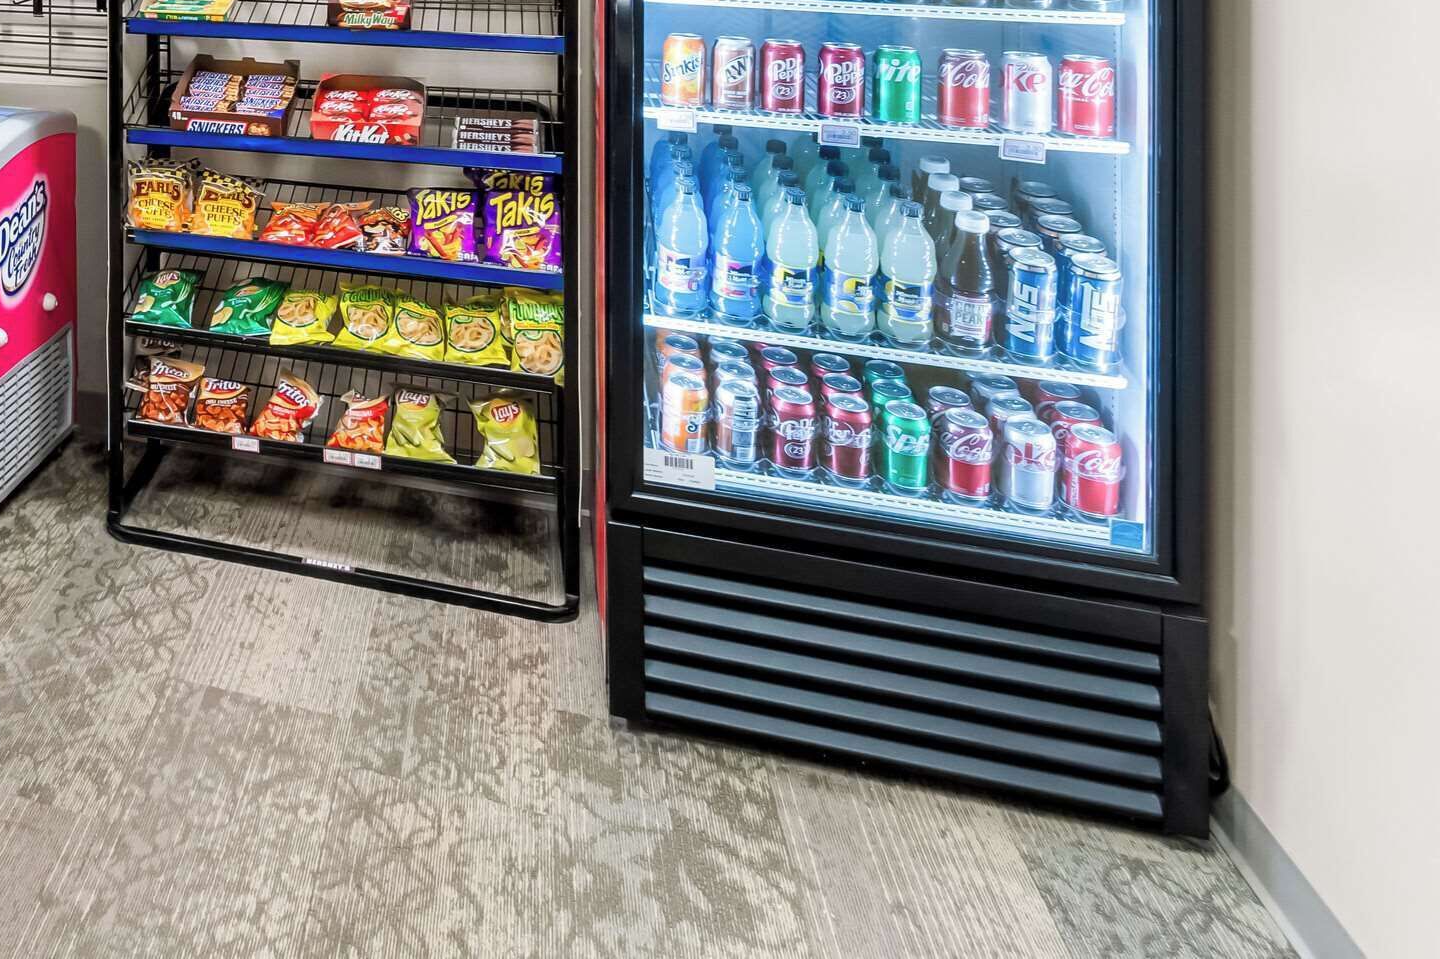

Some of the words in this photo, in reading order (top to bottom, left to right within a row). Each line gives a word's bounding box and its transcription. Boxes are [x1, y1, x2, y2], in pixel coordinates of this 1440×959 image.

[777, 85, 792, 96] 23
[835, 90, 848, 100] 23
[189, 120, 244, 135] SNICKERS
[204, 204, 246, 218] CHEESE
[415, 190, 472, 226] Takis
[489, 192, 555, 235] Takis
[206, 213, 241, 226] PUFFS
